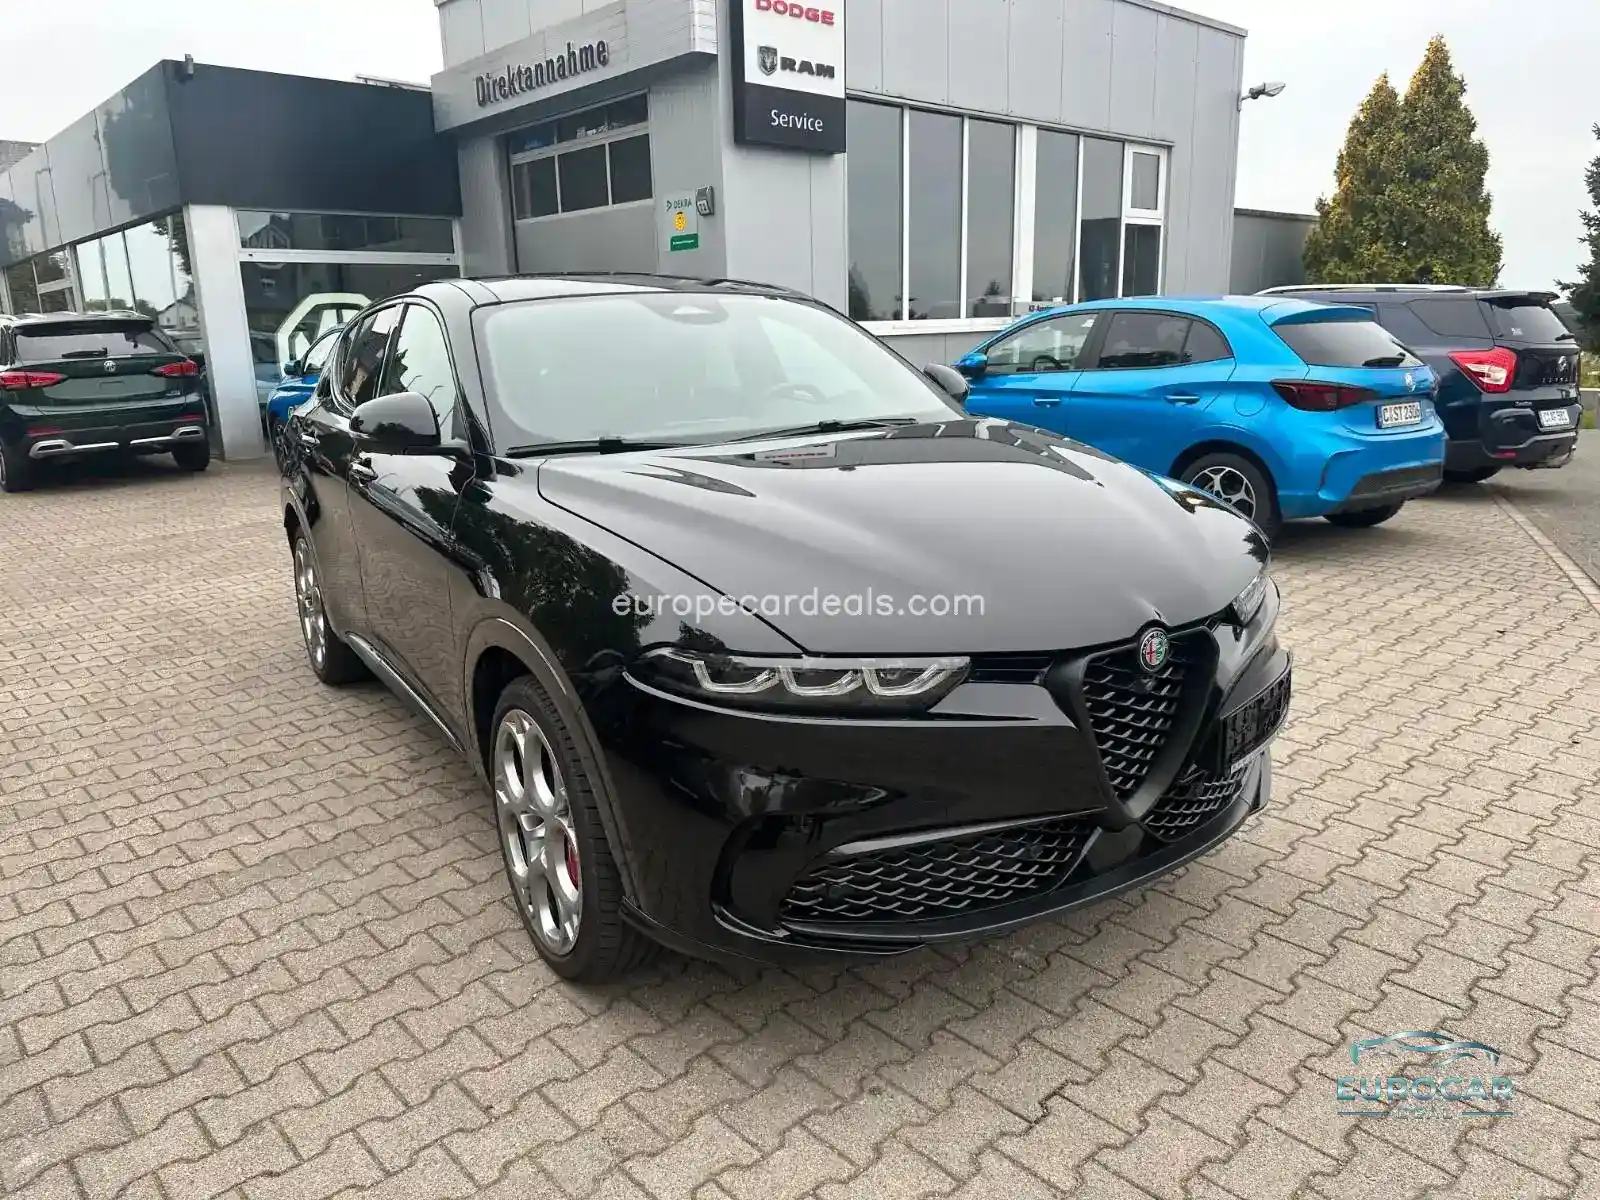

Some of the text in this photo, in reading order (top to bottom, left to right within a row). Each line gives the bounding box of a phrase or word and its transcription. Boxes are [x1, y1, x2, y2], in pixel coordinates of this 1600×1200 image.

[755, 0, 835, 26] DODGE
[475, 39, 609, 107] Direktannahme
[780, 56, 835, 79] RAM
[771, 109, 823, 132] Service
